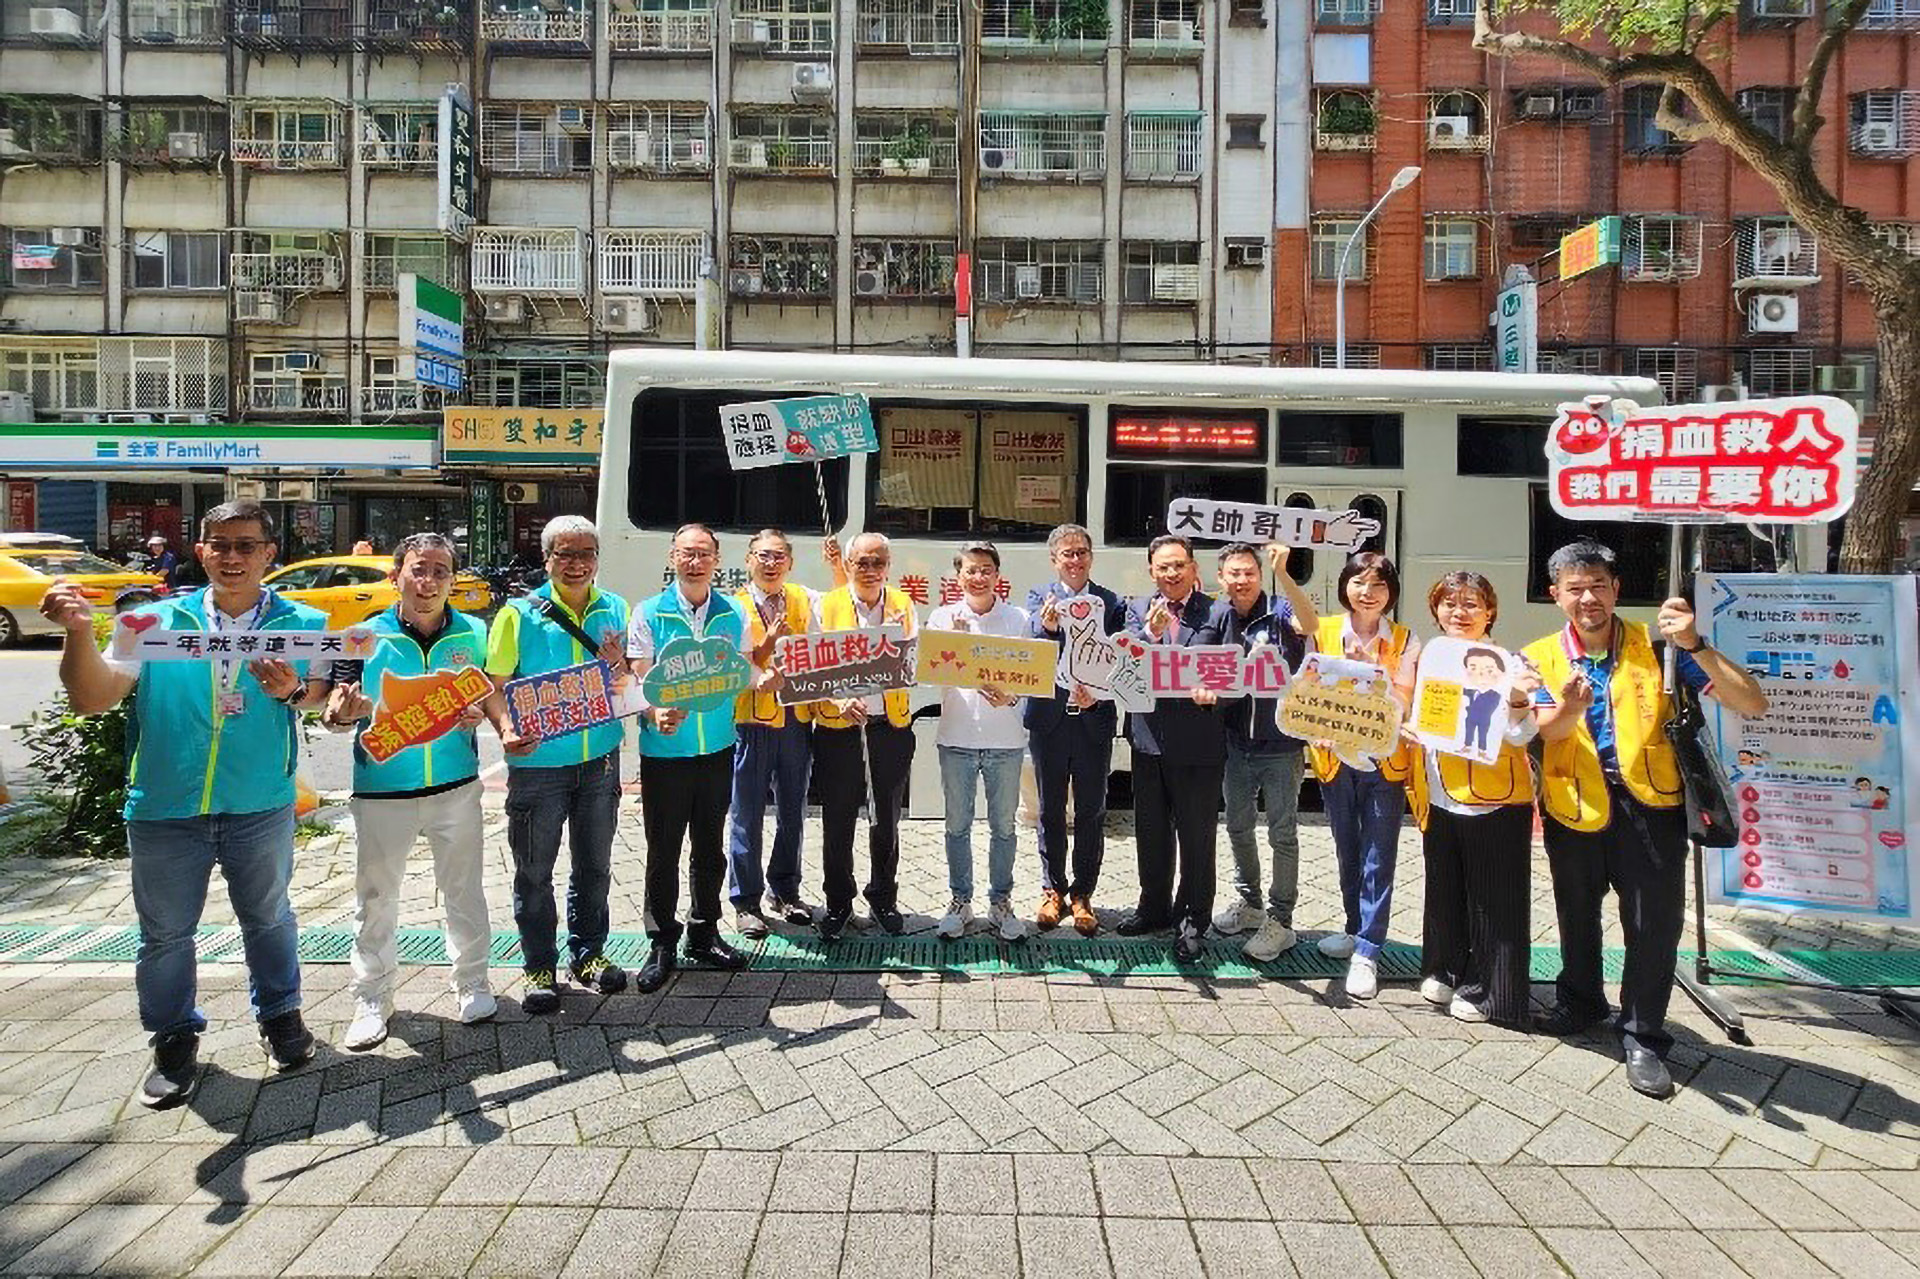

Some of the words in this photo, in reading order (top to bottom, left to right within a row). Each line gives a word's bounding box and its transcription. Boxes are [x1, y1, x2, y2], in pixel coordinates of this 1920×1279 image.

[166, 441, 261, 461] FamilyMart
[1620, 413, 1834, 459] 捐血救人
[1568, 464, 1830, 508] 我們需要你
[1175, 504, 1304, 541] 大帥哥!
[782, 633, 902, 674] 捐血救人
[1151, 650, 1287, 692] 比愛心
[820, 673, 860, 692] need
